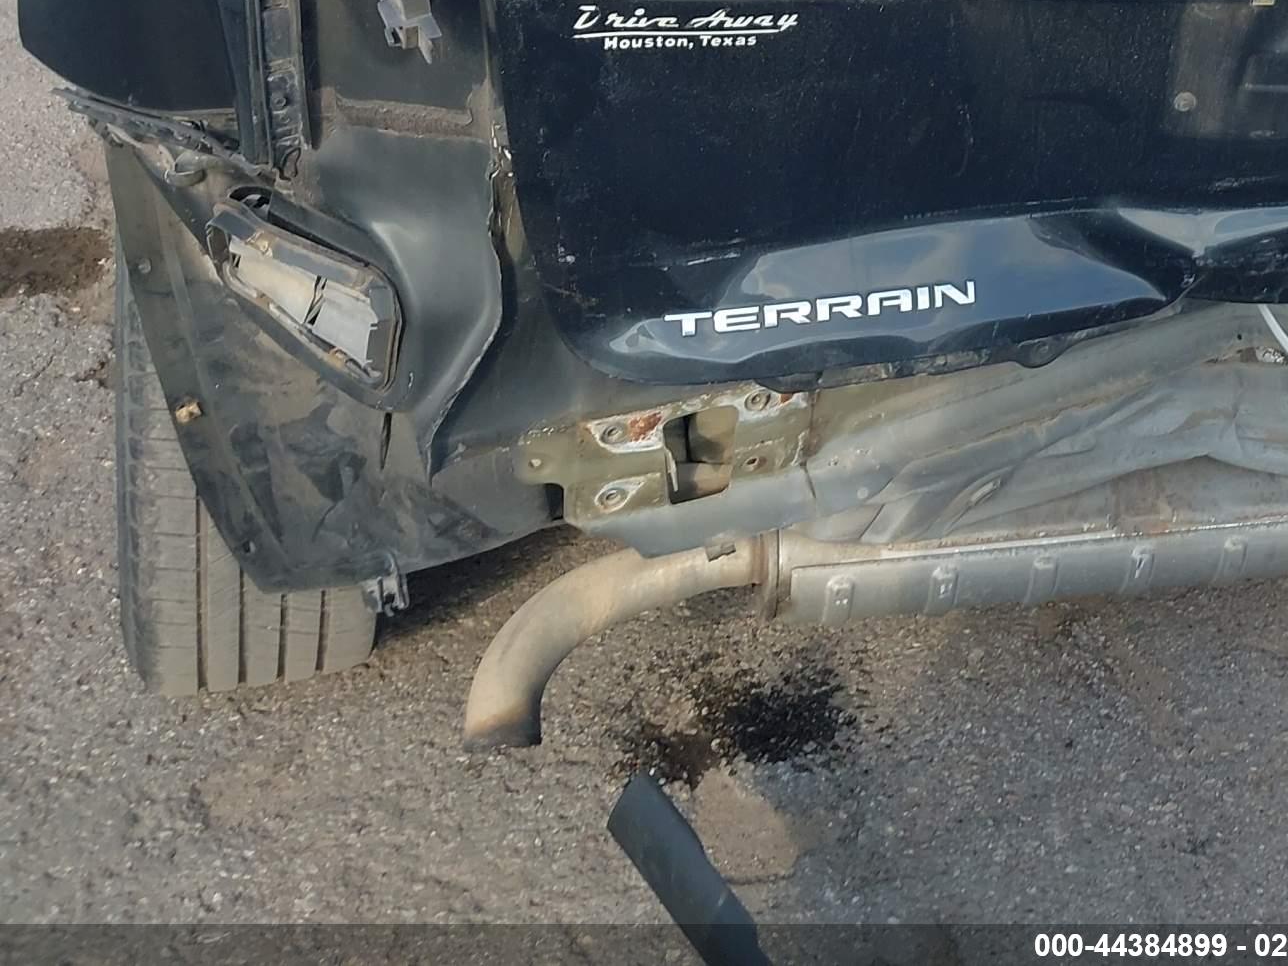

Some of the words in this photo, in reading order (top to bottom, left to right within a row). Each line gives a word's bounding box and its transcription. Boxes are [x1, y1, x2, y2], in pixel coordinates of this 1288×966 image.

[685, 8, 799, 32] Away
[603, 36, 694, 50] Houston,
[700, 35, 757, 47] Texas
[663, 280, 976, 337] TERRAIN
